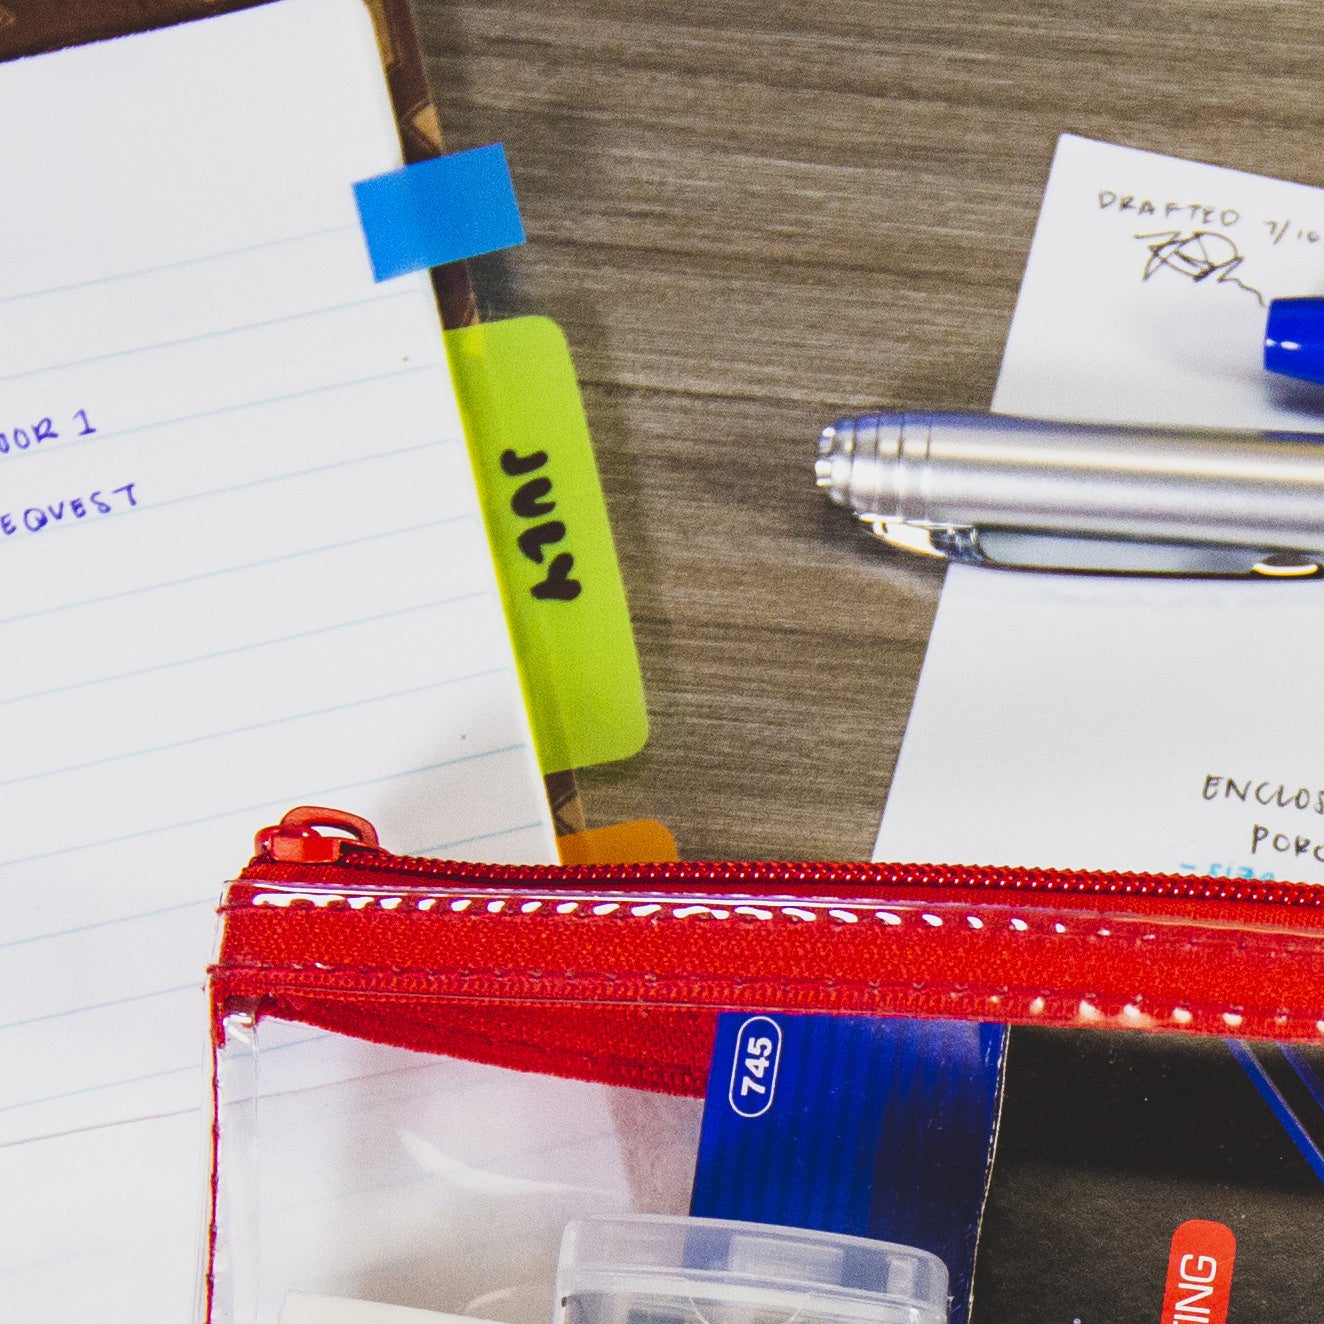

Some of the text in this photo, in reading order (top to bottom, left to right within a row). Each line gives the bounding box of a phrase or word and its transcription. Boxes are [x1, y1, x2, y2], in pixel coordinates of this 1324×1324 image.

[1098, 190, 1240, 227] DRAFTED
[73, 408, 97, 436] 1
[500, 449, 582, 601] JULY
[740, 1037, 773, 1096] 745
